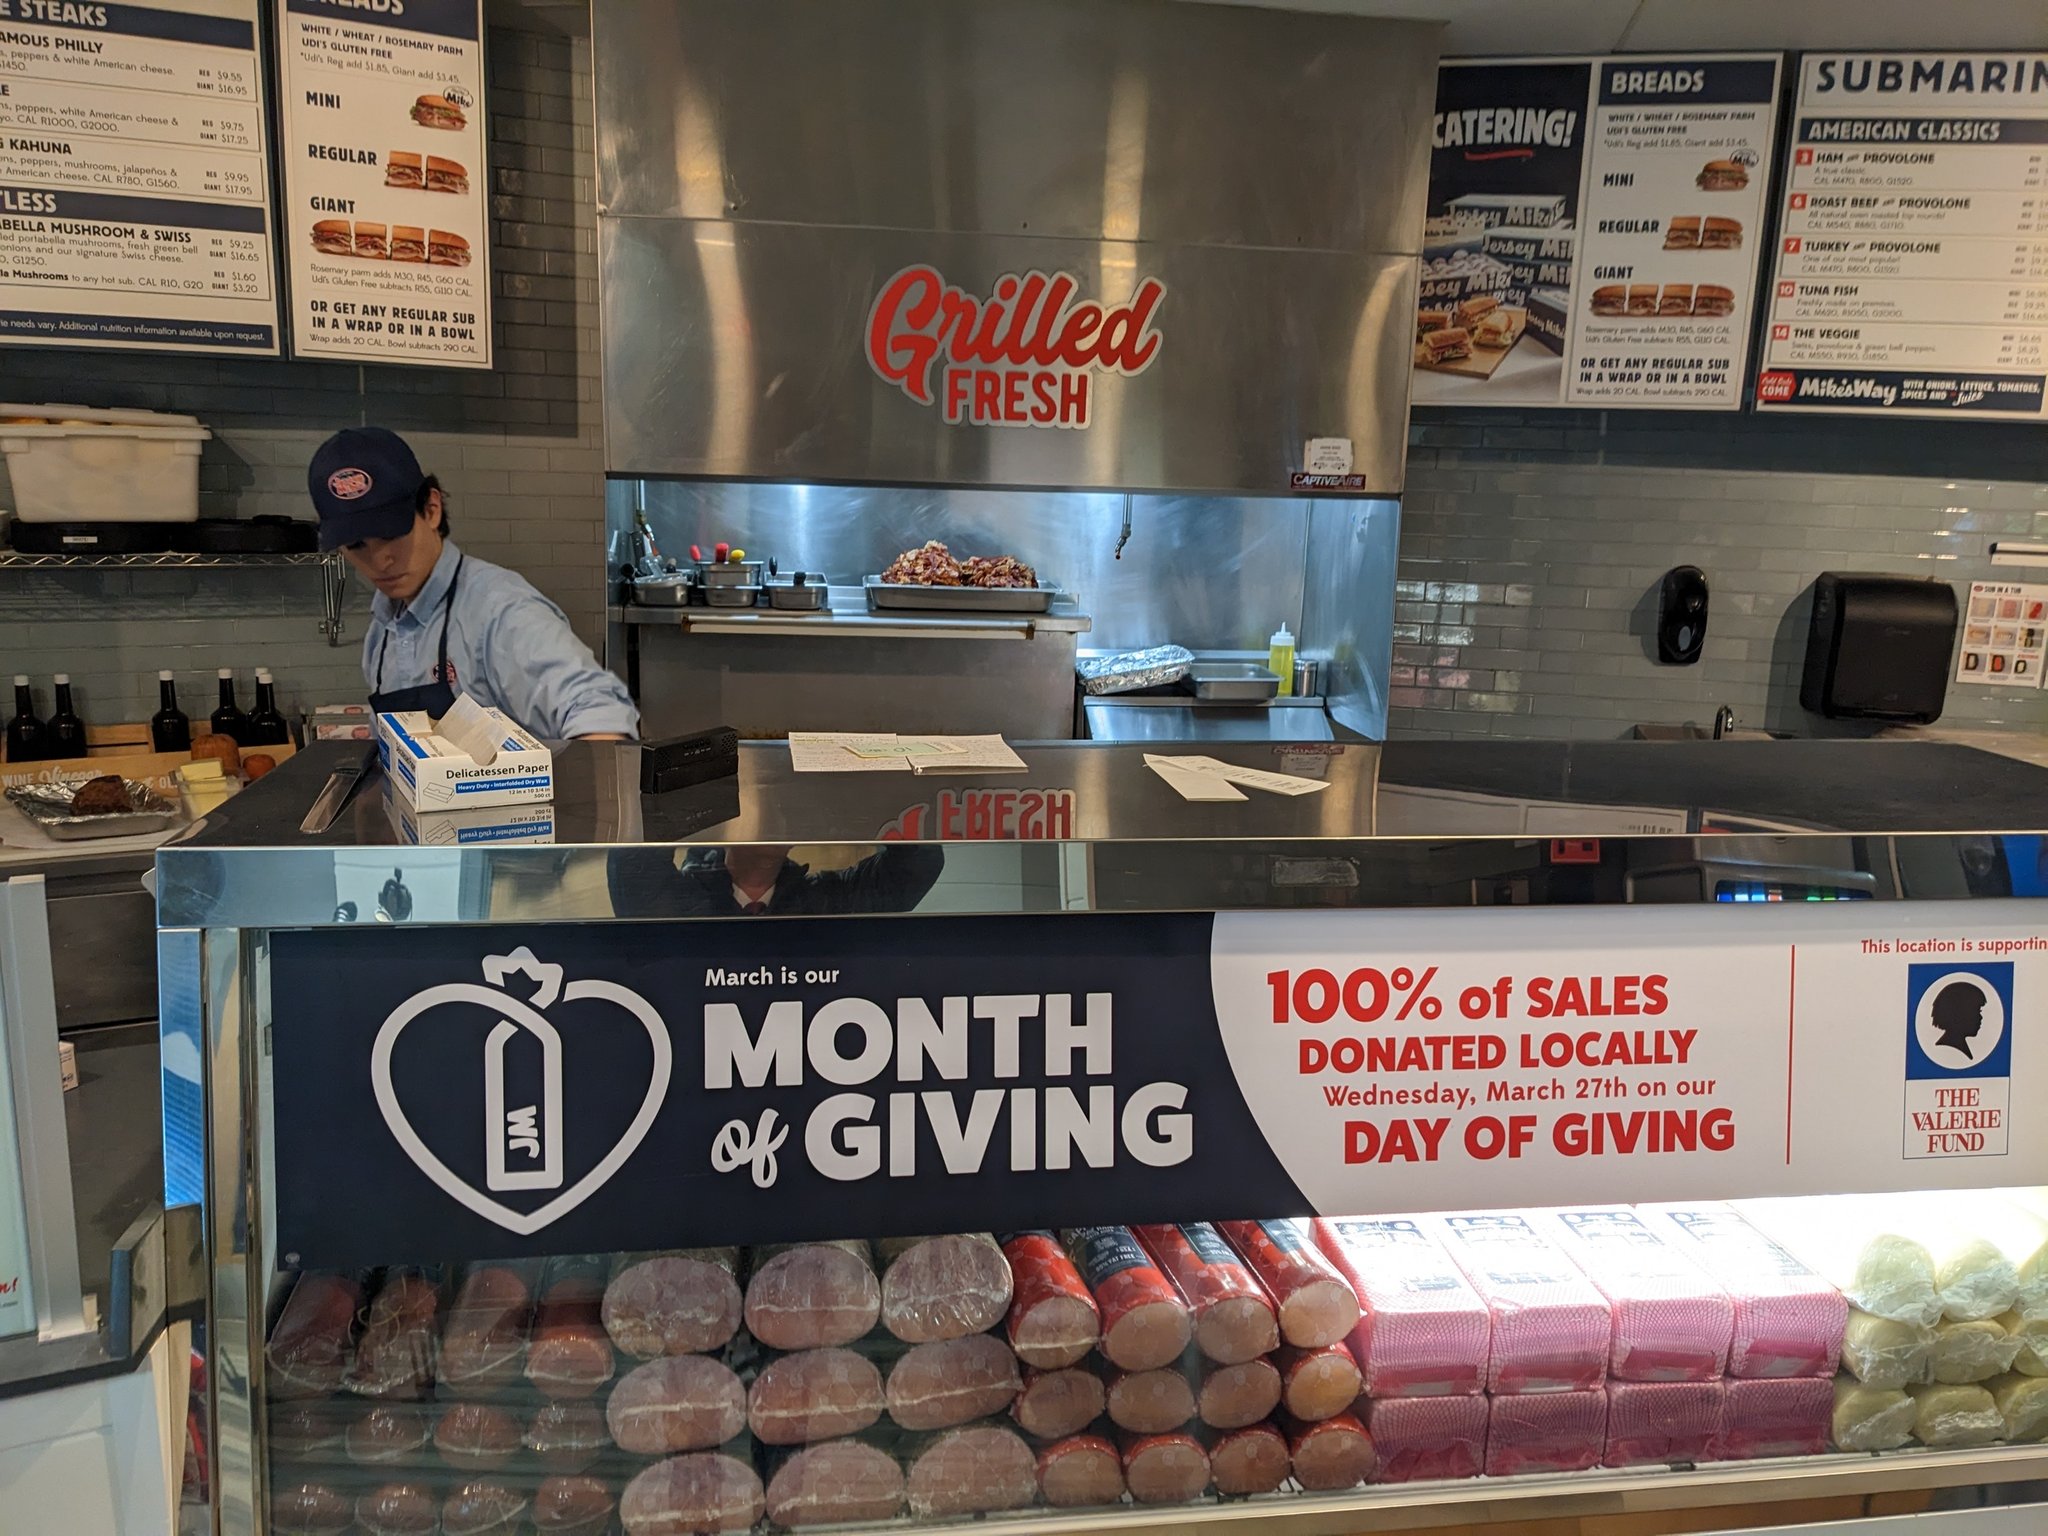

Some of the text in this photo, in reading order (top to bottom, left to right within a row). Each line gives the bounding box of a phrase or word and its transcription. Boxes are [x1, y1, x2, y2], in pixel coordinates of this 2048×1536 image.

[20, 0, 107, 26] STEAKS
[55, 38, 103, 53] PHILLY
[301, 23, 463, 56] WHITE WHEAT ROSEMARY PARM
[302, 38, 393, 59] UDI'S GLUTEN FREE
[11, 50, 175, 75] peppers & white American cheese.
[327, 56, 343, 69] Reg
[346, 60, 362, 69] add
[392, 66, 416, 77] Giant
[418, 70, 434, 79] add
[218, 71, 242, 81] $9.55
[1611, 70, 1704, 94] BREADS
[1816, 60, 2048, 93] SUBMARIN
[218, 85, 247, 95] $16.95
[306, 91, 341, 109] MINI
[17, 115, 37, 124] CAL
[80, 120, 119, 132] G2000.
[60, 107, 85, 117] white
[89, 109, 132, 122] American
[136, 115, 169, 126] cheese
[221, 120, 244, 131] $9.75
[1433, 108, 1576, 148] CATERING!
[1809, 122, 2000, 140] AMERICAN CLASSICS
[10, 139, 72, 155] KAHUNA
[308, 144, 377, 165] REGULAR
[1816, 153, 1935, 164] HAM PROVOLONE
[224, 172, 249, 182] $9.95
[1603, 174, 1634, 187] MINI
[310, 197, 355, 214] GIANT
[1810, 197, 1970, 209] ROAST BEEF PROVOLONE
[51, 223, 191, 242] MUSHROOM & SWISS
[1599, 221, 1659, 233] REGULAR
[230, 240, 254, 249] $9.25
[1805, 241, 1941, 253] TURKEY PROVOLONE
[231, 252, 259, 261] $16.65
[232, 272, 256, 281] $1.60
[1594, 266, 1634, 279] GIANT
[233, 284, 258, 293] $3.20
[1780, 285, 1858, 295] 10 TUNA FISH
[311, 300, 475, 324] OR GET ANY REGULAR SUB
[10, 320, 35, 328] needs
[38, 322, 57, 331] vary.
[59, 321, 97, 331] Additional
[100, 325, 131, 333] nutrition
[179, 328, 212, 337] available
[214, 331, 233, 339] upon
[236, 332, 264, 341] request.
[312, 317, 475, 340] IN A WRAP OR IN A BOWL
[870, 268, 1161, 400] Grilled
[1775, 328, 1860, 339] 14 THE VEGGIE
[1581, 358, 1729, 369] OR GET ANY REGULAR SUB
[1580, 373, 1726, 383] IN A WRAP OR IN A BOWL
[1903, 380, 2040, 393] WITH ONIONS, LETTUCE, TOMATOES,
[948, 369, 1087, 423] FRESH
[1762, 385, 1789, 396] COME
[1901, 391, 1984, 406] SPICES AND Juice
[1, 773, 33, 786] WINE
[446, 764, 549, 779] Delicatessen Paper
[1861, 937, 2047, 955] This location is supportin
[704, 966, 839, 986] March is our
[1267, 966, 1668, 1024] 100% of SALES
[704, 992, 1113, 1089] MONTH
[1299, 1029, 1698, 1074] DONATED LOCALLY
[1323, 1076, 1715, 1111] Wednesday, March 27th on our
[1935, 1088, 1980, 1108] THE
[1912, 1110, 2000, 1131] VALERIE
[710, 1081, 1193, 1188] of GIVING
[1344, 1108, 1735, 1165] DAY OF GIVING
[1927, 1132, 1984, 1154] FUND
